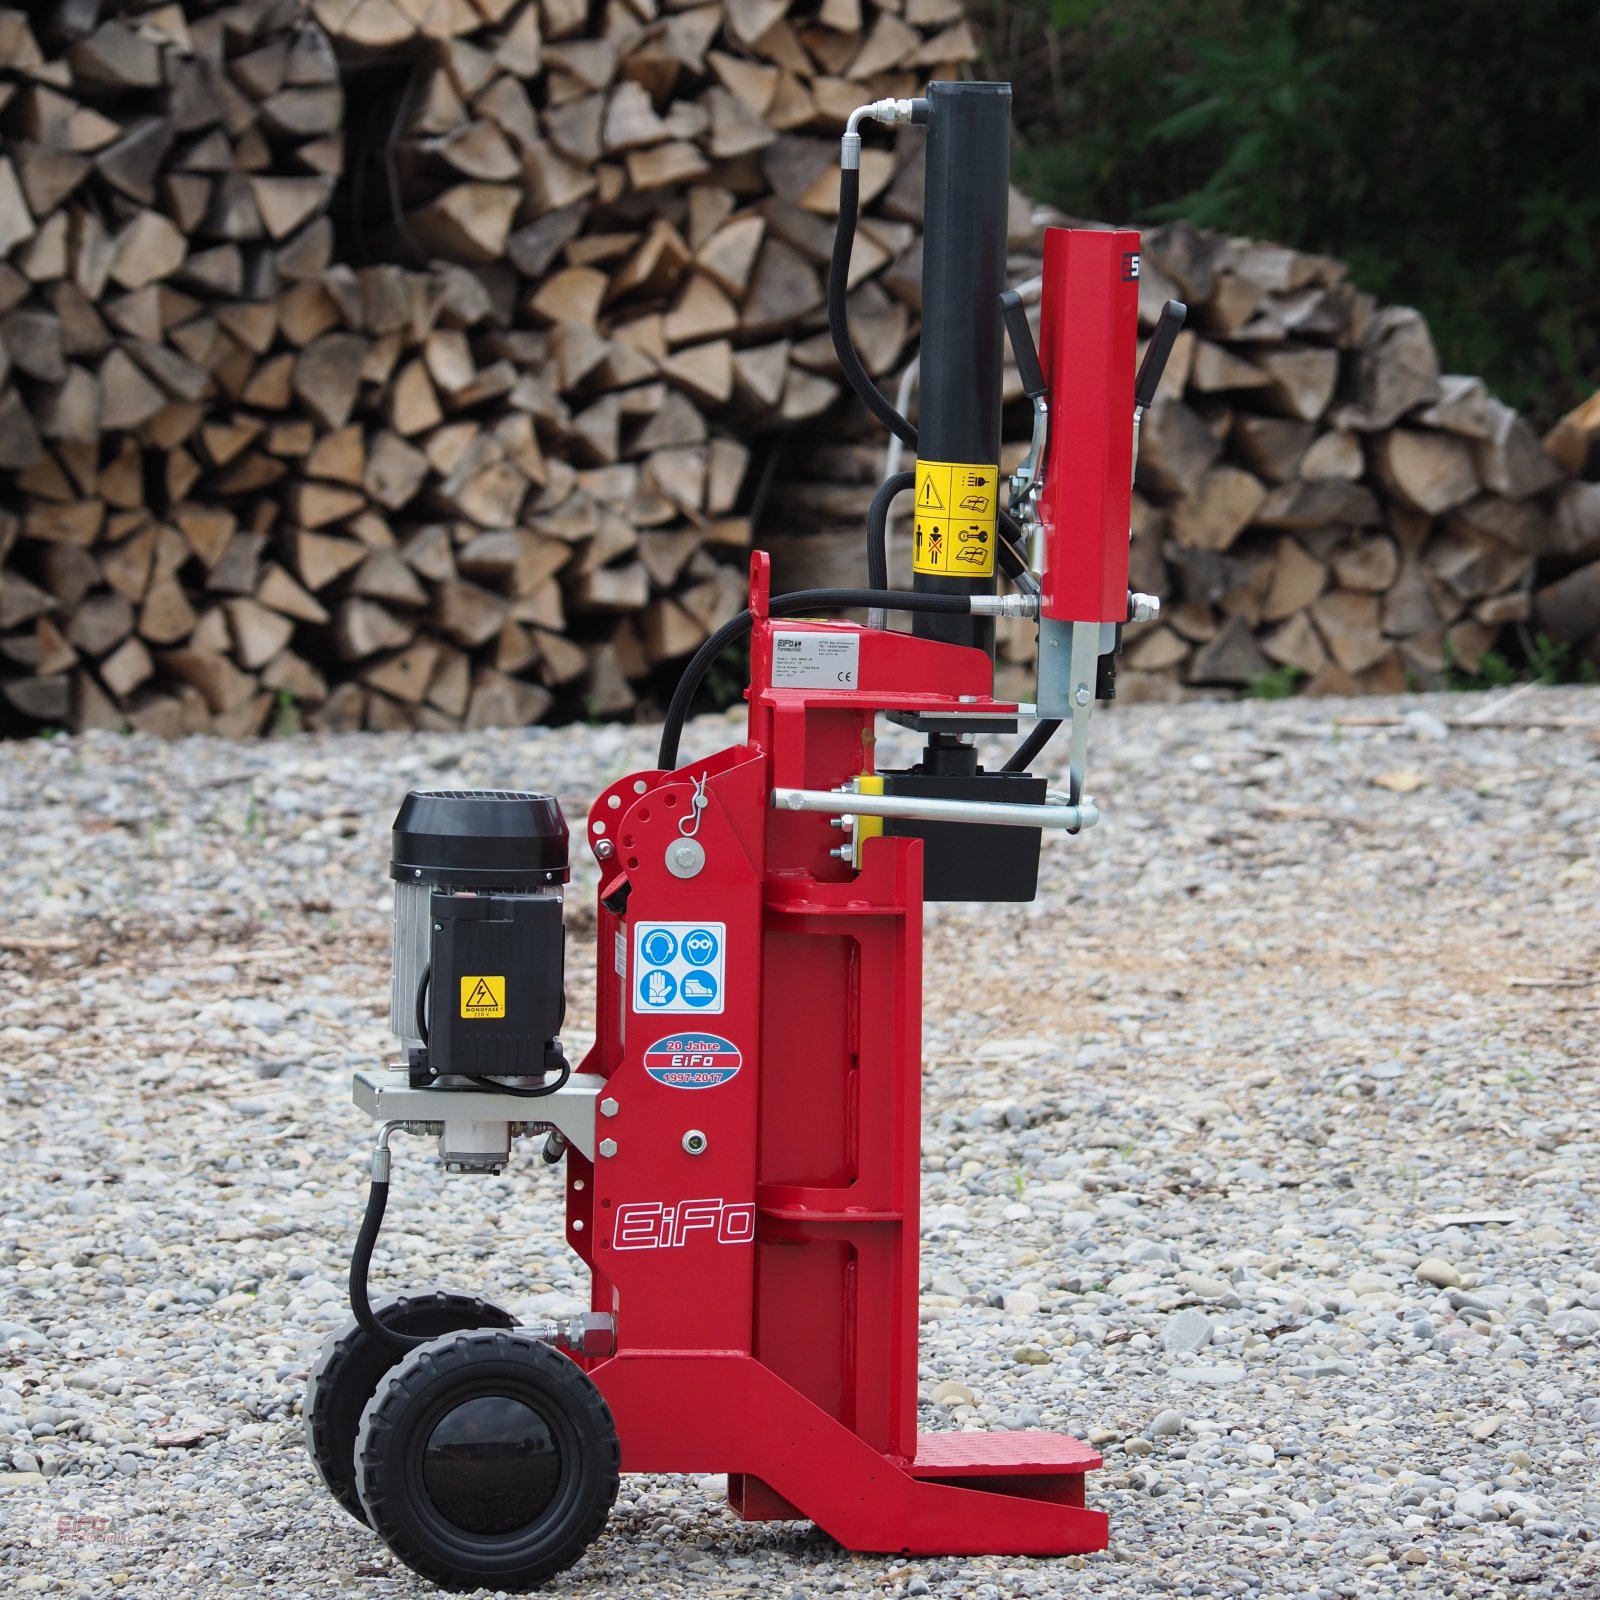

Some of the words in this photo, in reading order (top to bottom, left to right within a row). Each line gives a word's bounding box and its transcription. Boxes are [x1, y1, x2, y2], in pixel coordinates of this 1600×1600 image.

[667, 1041, 682, 1051] 20
[685, 1041, 720, 1051] Jahre
[671, 1055, 715, 1067] EiFo
[663, 1073, 723, 1082] 1997-2017
[612, 1198, 756, 1251] EiFo
